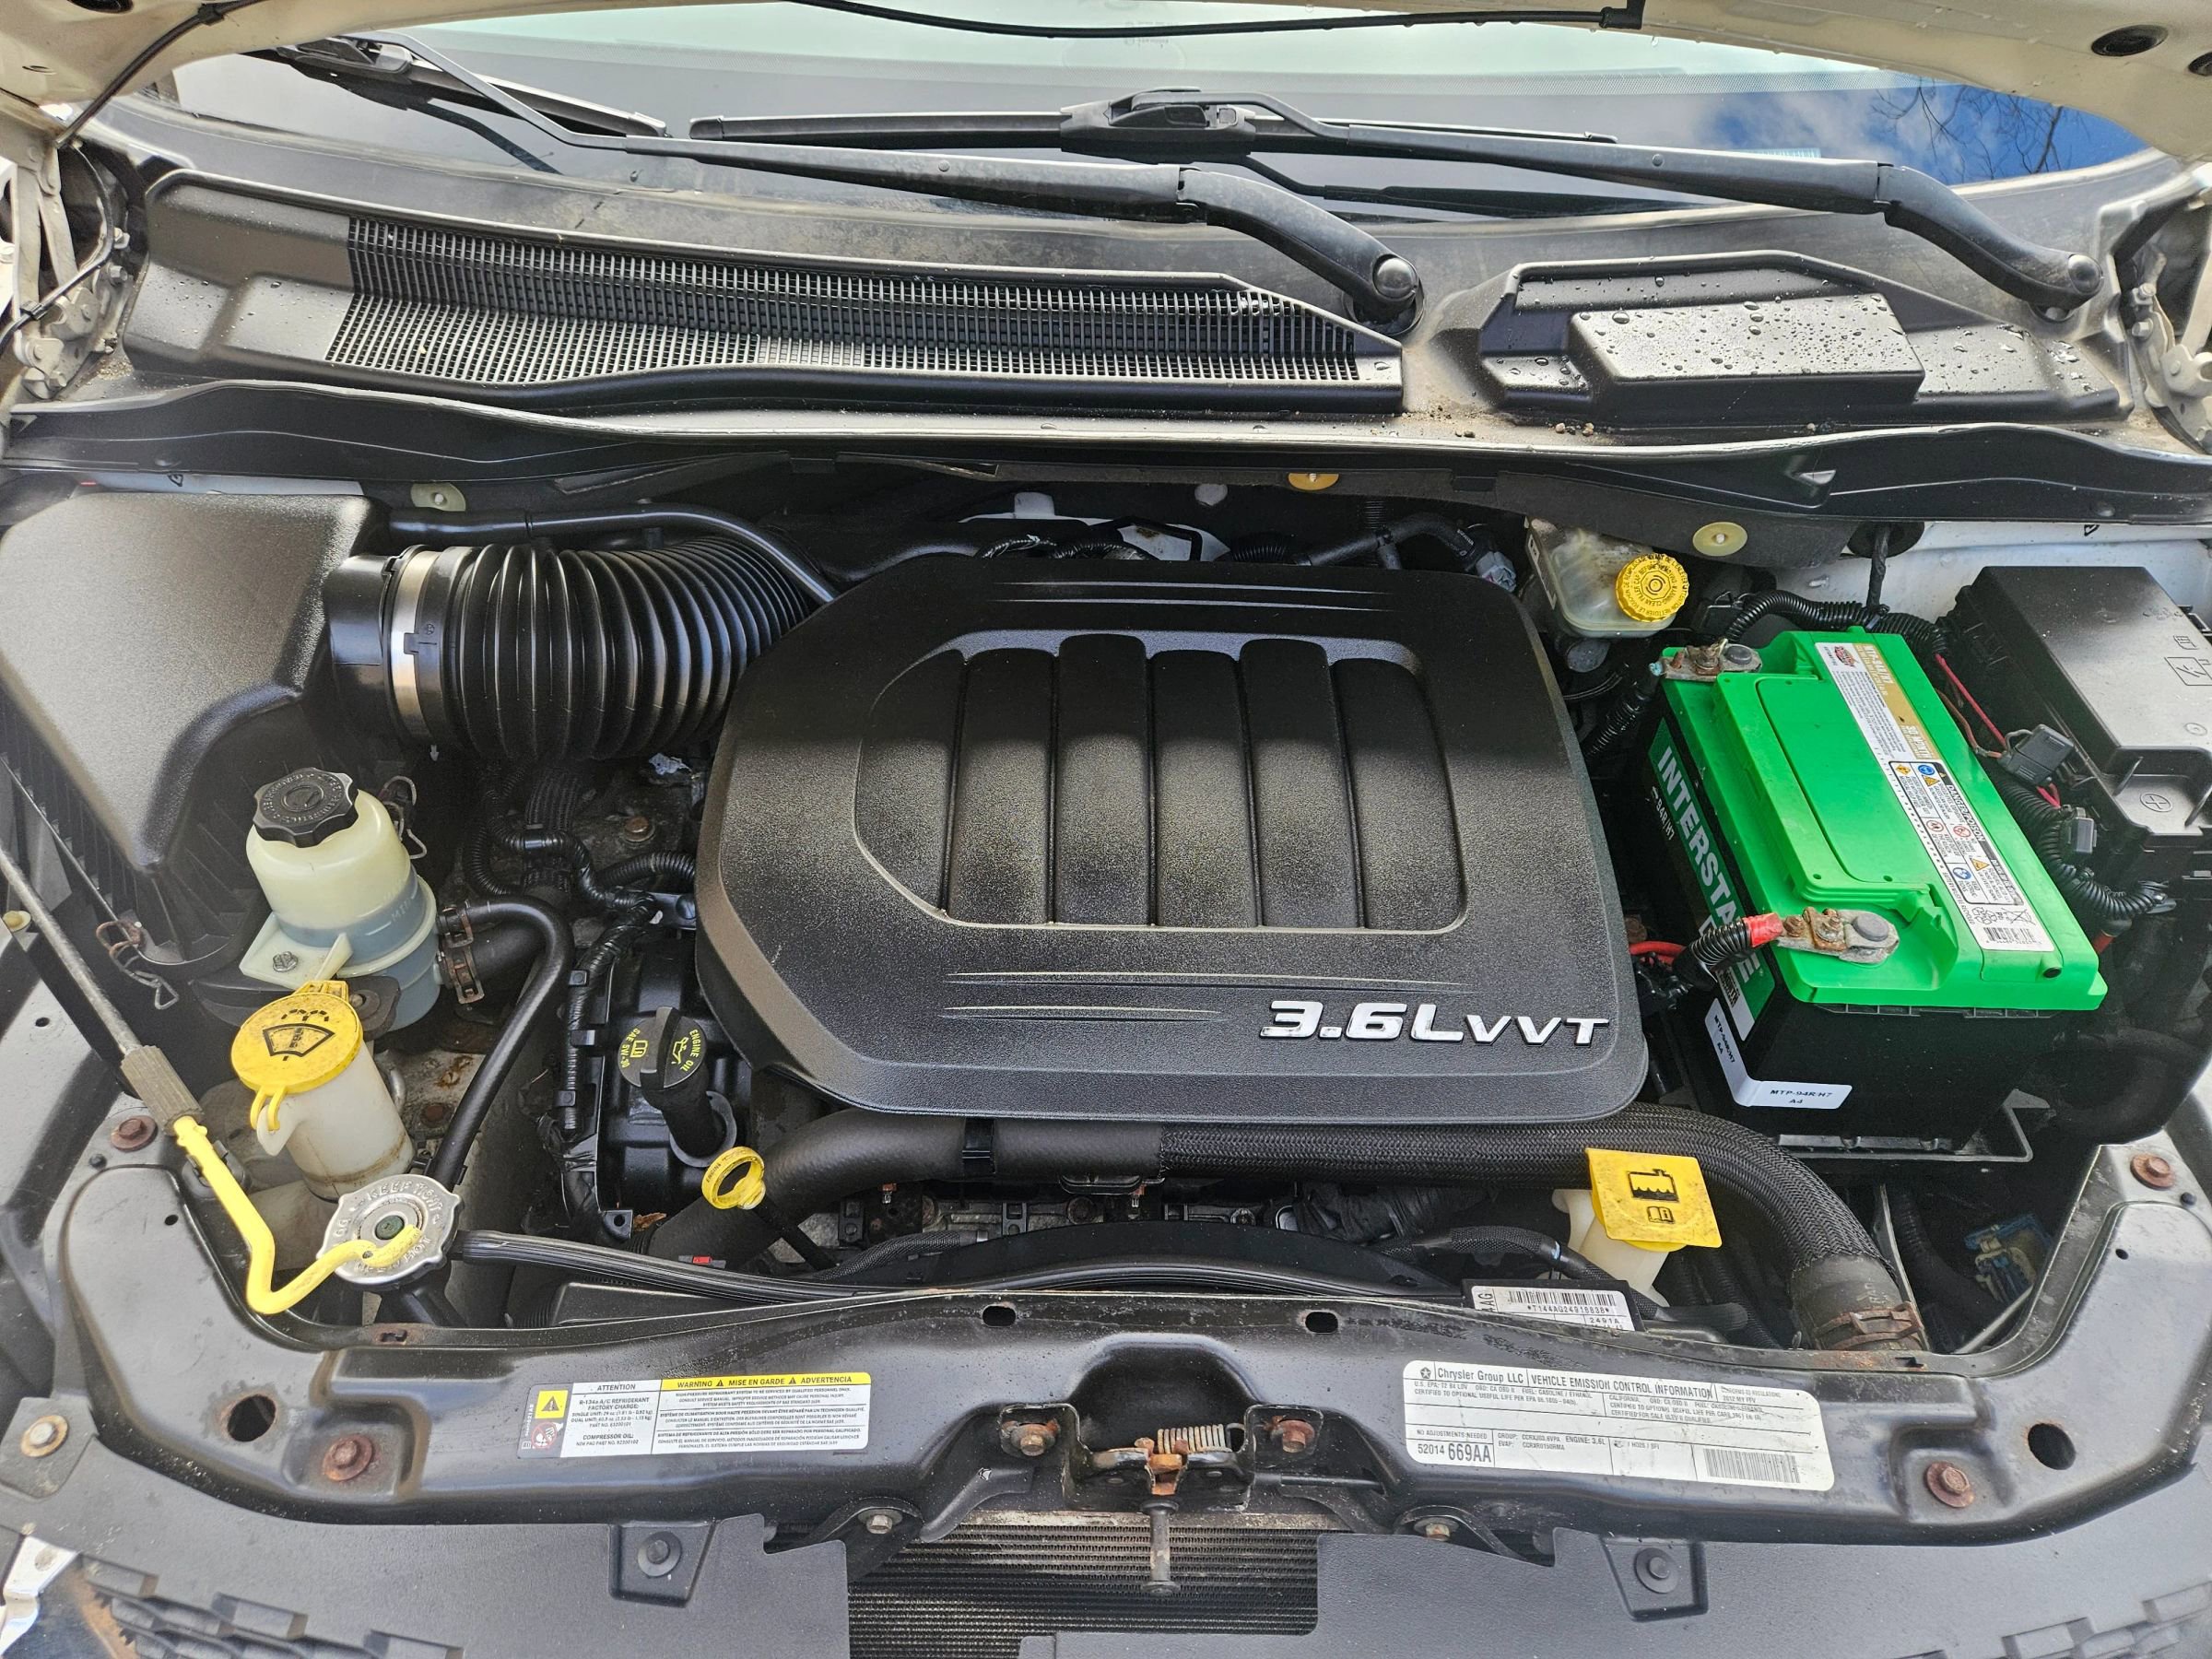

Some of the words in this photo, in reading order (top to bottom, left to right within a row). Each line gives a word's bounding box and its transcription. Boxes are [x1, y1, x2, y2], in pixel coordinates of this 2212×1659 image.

[1945, 784, 1985, 841] DANGER/POISON
[1658, 747, 1761, 984] INTERSTAE
[1259, 1000, 1465, 1041] 3.6L
[1465, 1015, 1610, 1047] VVT
[626, 1028, 641, 1042] SAE
[689, 1029, 701, 1058] ENGINE
[620, 1044, 630, 1068] 5W-30
[680, 1060, 694, 1072] OIL
[367, 1181, 413, 1201] KEEP
[412, 1182, 443, 1212] TIGHT
[1589, 1316, 1620, 1324] 2491A
[1437, 1367, 1474, 1381] Chrysler
[1477, 1370, 1503, 1383] Group
[1507, 1372, 1523, 1384] LLC
[1531, 1374, 1566, 1386] VEHICLE
[1570, 1377, 1610, 1390] EMISSION
[1613, 1380, 1652, 1393] CONTROL
[1654, 1383, 1712, 1397] INFORMATION
[1426, 1429, 1464, 1437] ADJUSTMENTS
[1565, 1435, 1590, 1443] ENGINE:
[1418, 1442, 1444, 1454] 52014
[1447, 1442, 1490, 1462] 669AA
